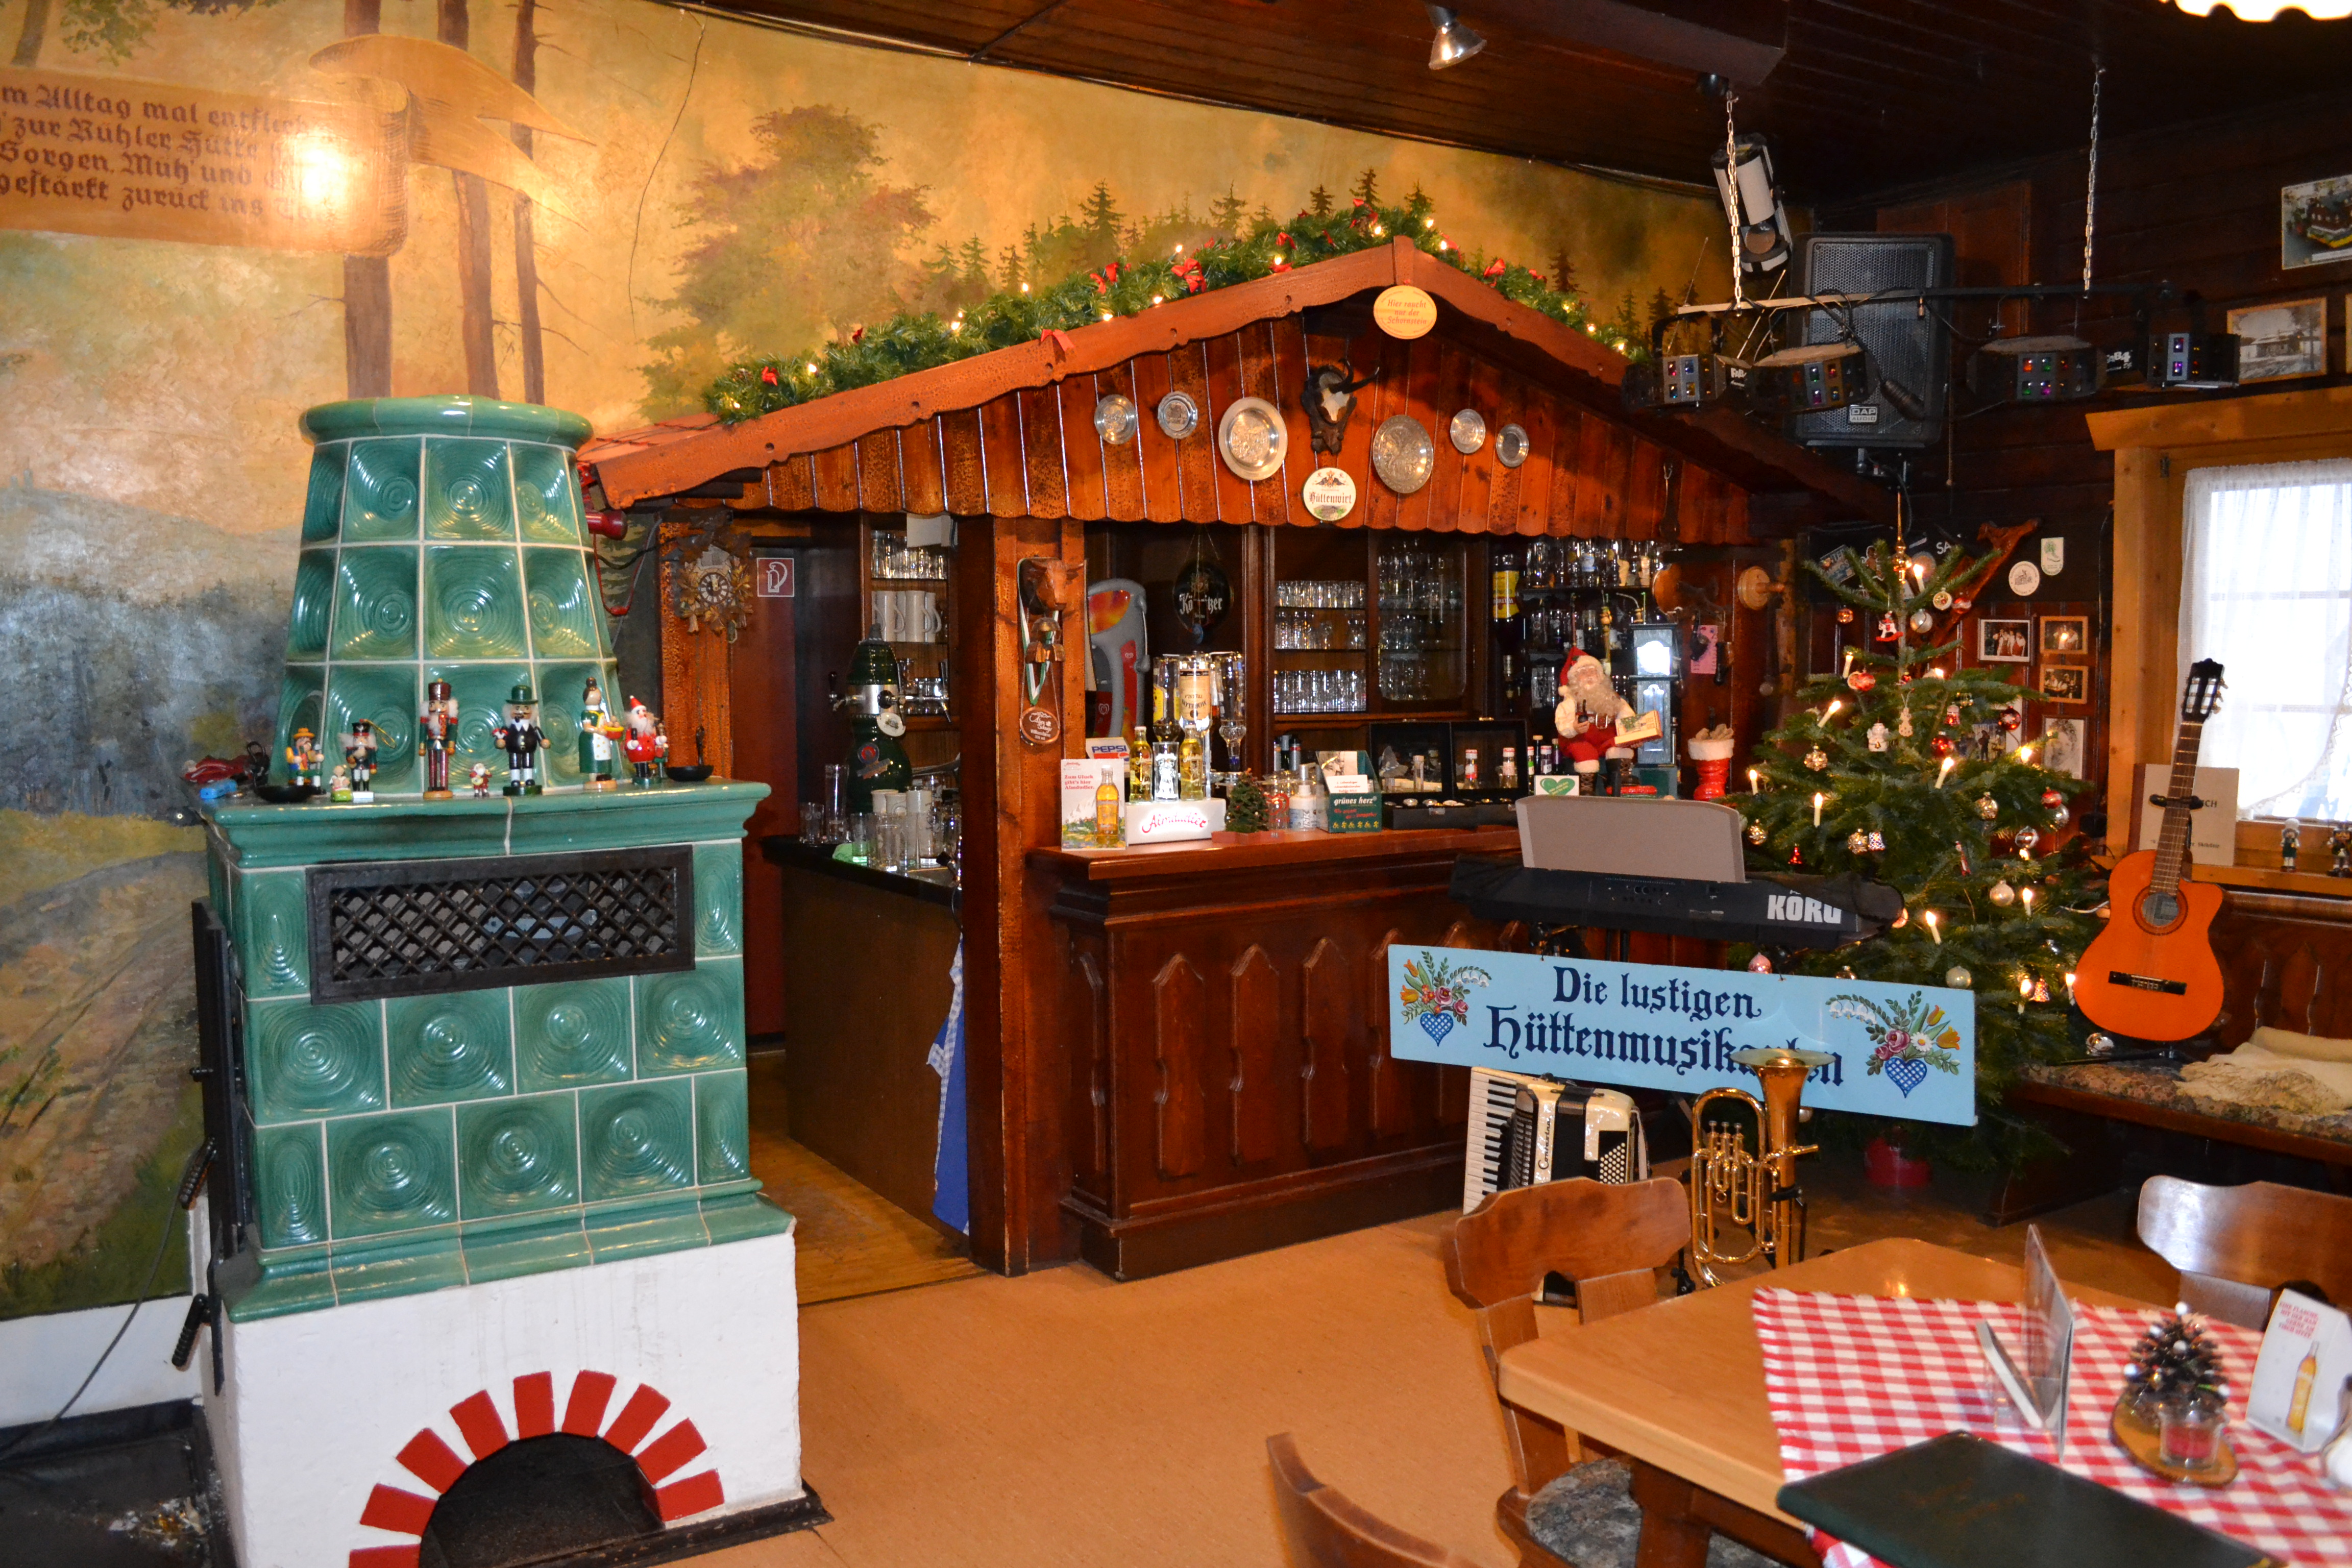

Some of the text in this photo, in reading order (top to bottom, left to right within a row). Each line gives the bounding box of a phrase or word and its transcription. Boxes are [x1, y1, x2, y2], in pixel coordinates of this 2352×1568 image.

[35, 84, 131, 120] Alltag
[143, 101, 198, 124] mal
[13, 116, 61, 139] zur
[200, 163, 252, 186] und
[121, 187, 209, 212] zurück
[1404, 300, 1427, 308] raucht
[1387, 315, 1427, 325] Schornstein
[1309, 492, 1352, 504] Hüttenwirt
[1179, 593, 1223, 615] Kötzer
[1334, 797, 1357, 806] grünes
[1767, 895, 1842, 924] KORG
[1553, 965, 1762, 1022] Die lustigen
[1483, 1004, 1844, 1087] Hüttenmusikn
